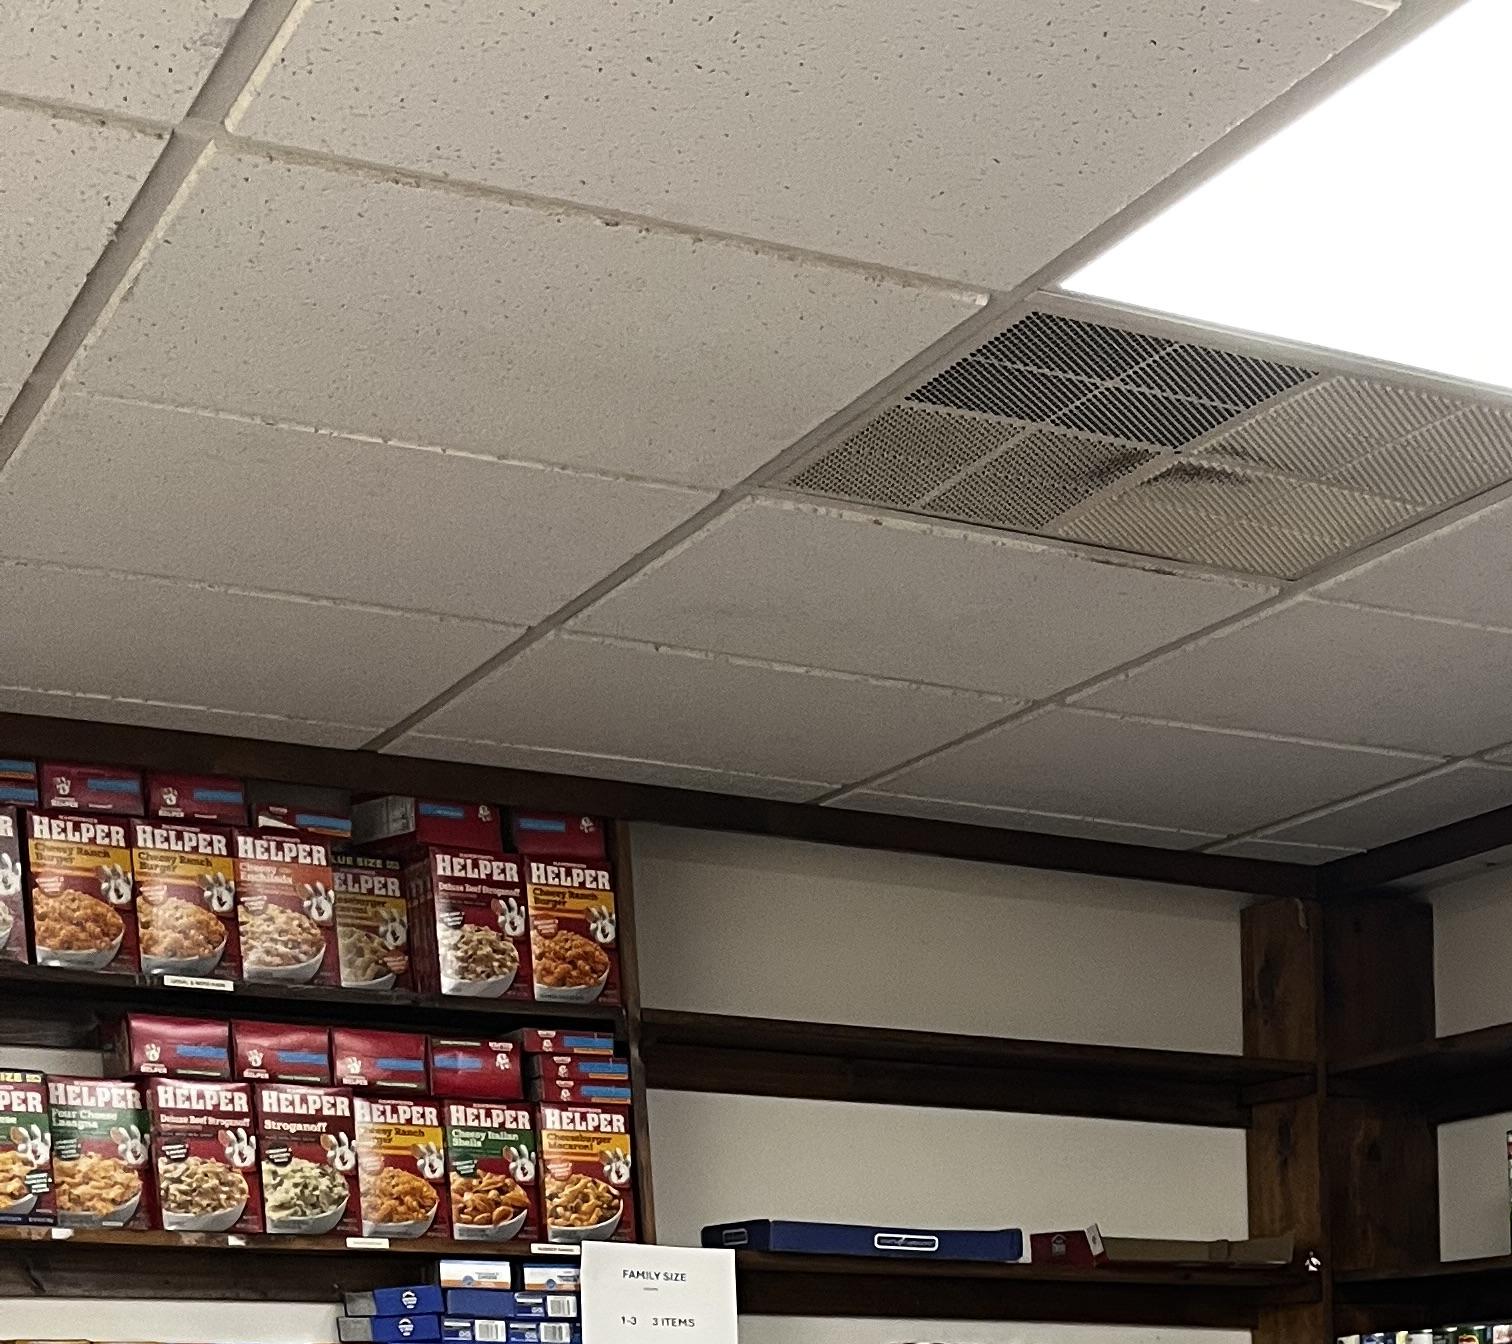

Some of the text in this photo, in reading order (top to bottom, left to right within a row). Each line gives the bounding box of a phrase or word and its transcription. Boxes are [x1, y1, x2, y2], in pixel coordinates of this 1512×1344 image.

[32, 816, 126, 847] HELPER
[136, 825, 227, 855] HELPER
[237, 836, 327, 866] HELPER
[435, 854, 519, 883] HELPER
[531, 862, 611, 890] HELPER
[50, 1082, 142, 1110] HELPER
[158, 1085, 249, 1112] HELPER
[262, 1089, 350, 1117] HELPER
[355, 1097, 438, 1126] HELPER
[450, 1105, 531, 1130] HELPER
[545, 1108, 625, 1133] HELPER
[264, 1119, 327, 1133] Stroganoff
[623, 1270, 687, 1282] FAMILY SIZE
[621, 1316, 695, 1327] 1-3 3 ITEMS
